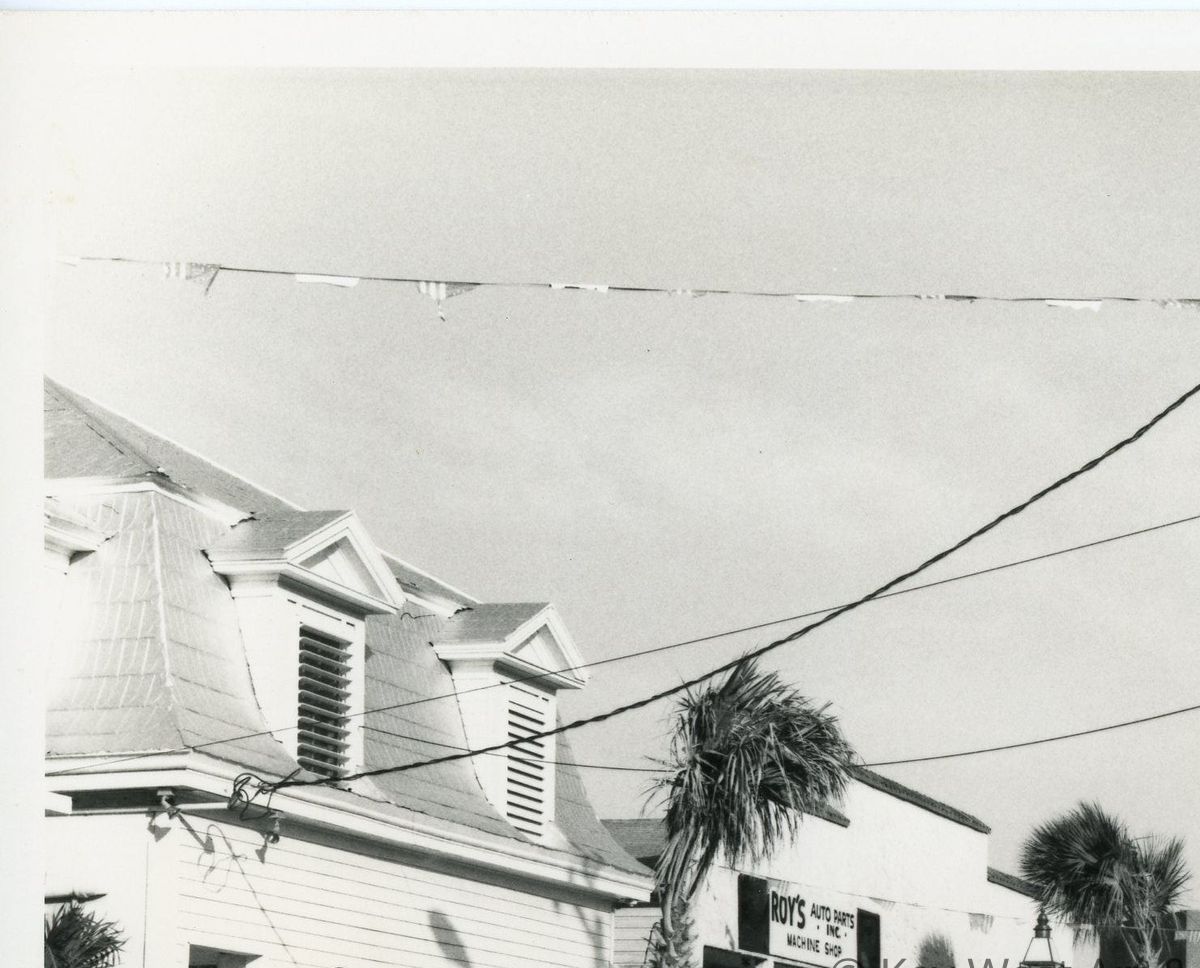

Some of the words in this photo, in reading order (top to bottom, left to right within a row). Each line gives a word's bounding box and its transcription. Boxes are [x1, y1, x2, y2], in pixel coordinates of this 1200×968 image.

[771, 890, 806, 929] ROY'S
[810, 902, 832, 922] AUTO
[833, 909, 855, 929] PARTS
[786, 932, 821, 953] MACHINE
[824, 941, 843, 958] SHOP
